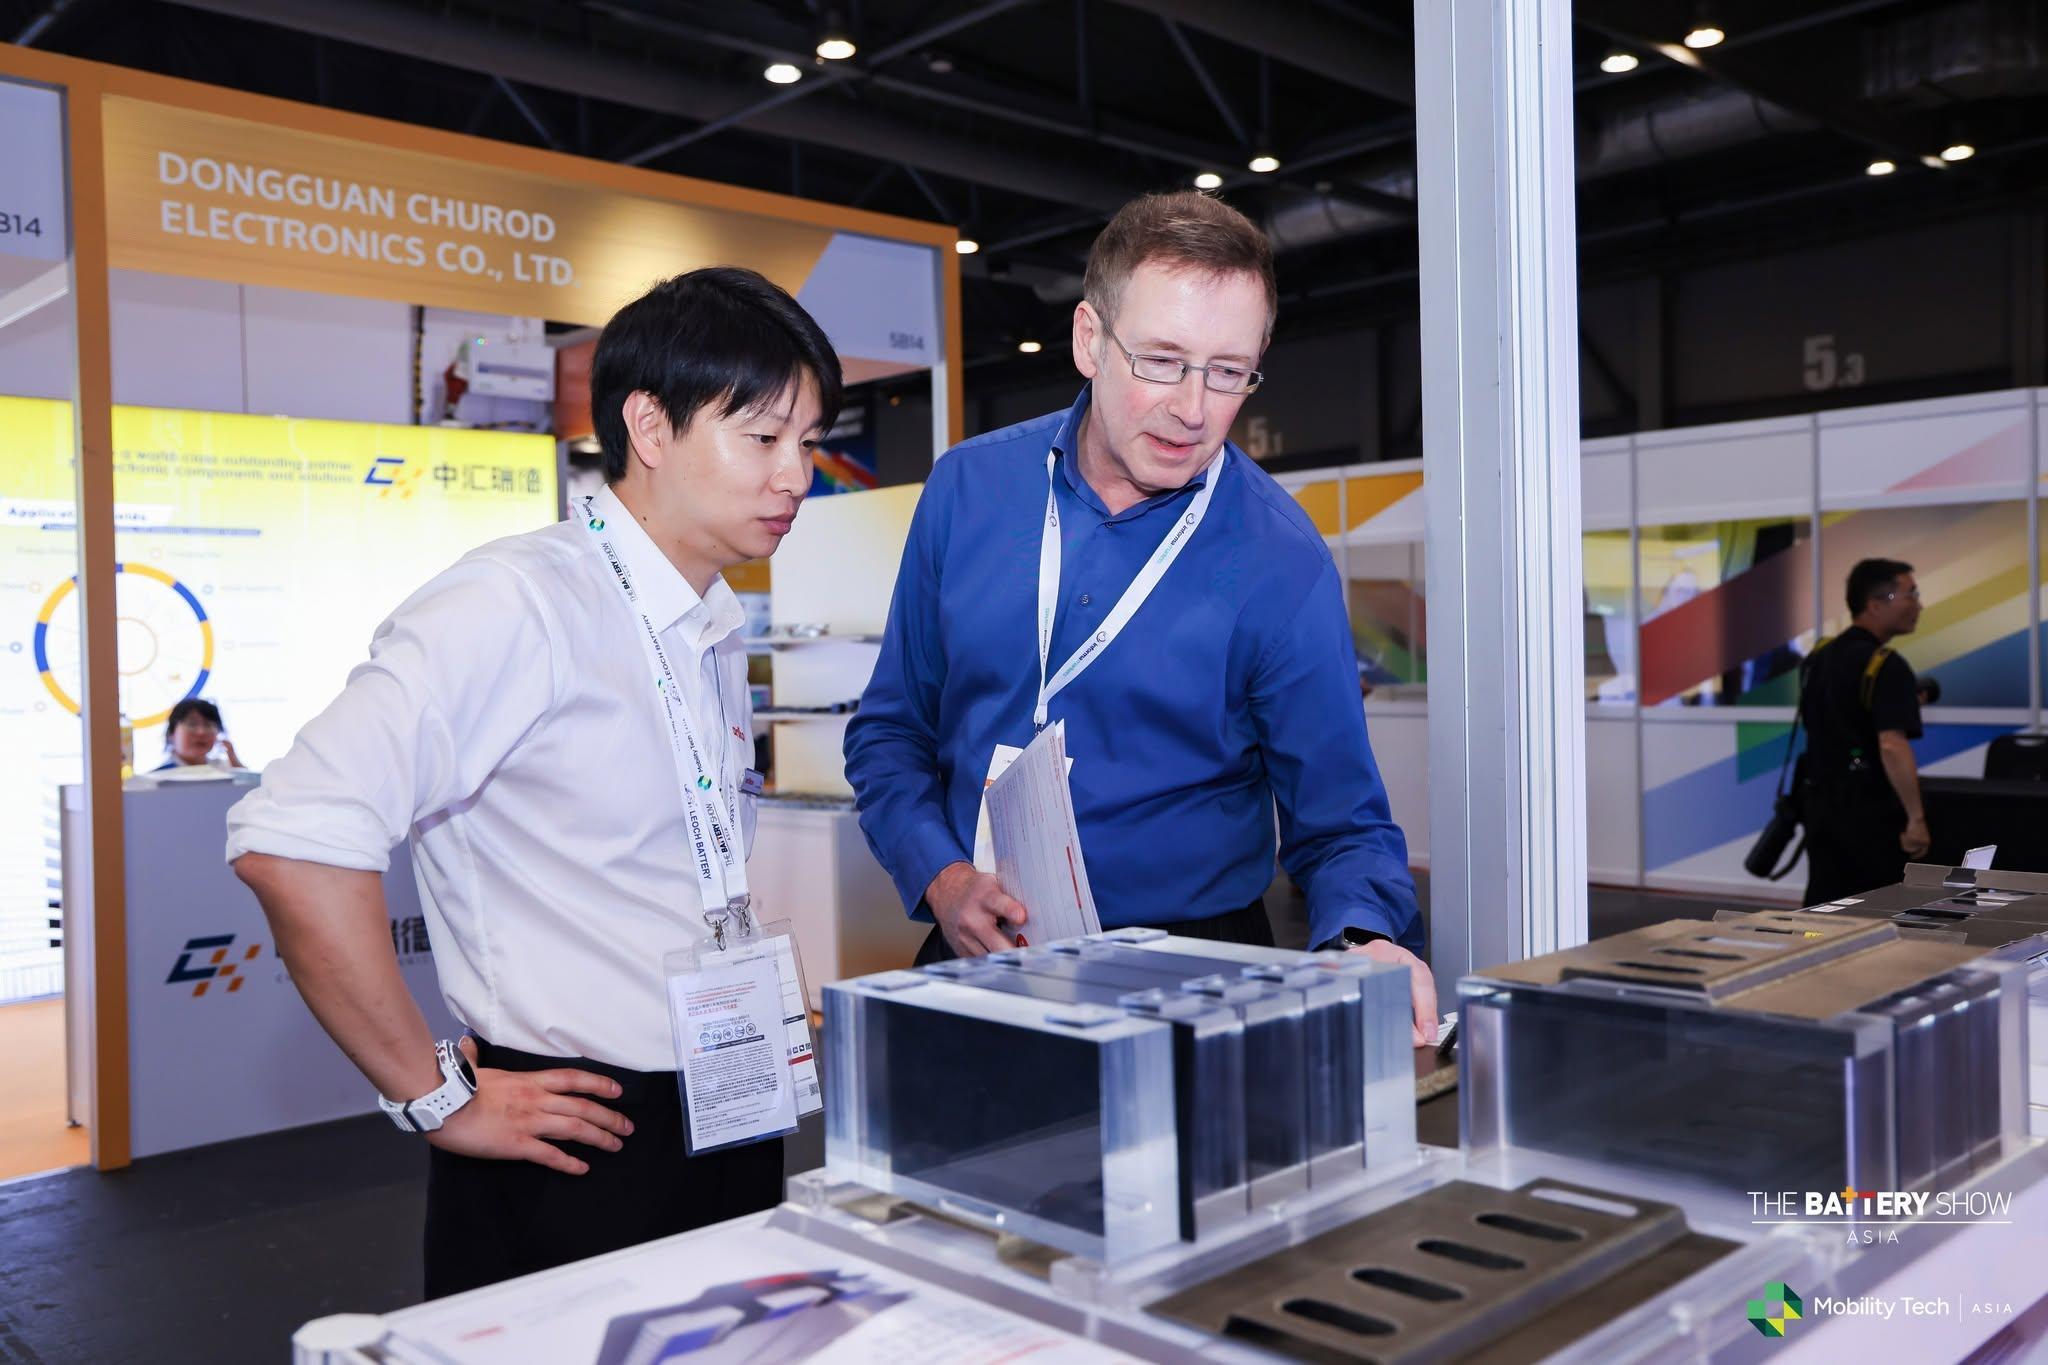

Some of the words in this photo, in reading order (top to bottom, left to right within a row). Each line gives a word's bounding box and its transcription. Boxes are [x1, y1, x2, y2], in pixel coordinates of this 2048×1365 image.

[159, 151, 395, 219] DONGGUAN
[406, 193, 556, 242] CHUROD
[160, 200, 427, 267] ELECTRONICS
[436, 240, 503, 283] CO.,
[513, 251, 582, 288] LTD.
[1803, 335, 1866, 390] 5.3
[1171, 525, 1188, 546] informa
[658, 652, 673, 680] LEOCH
[1078, 642, 1098, 661] informa
[690, 810, 702, 840] LEOCH
[712, 823, 728, 853] BATTERY
[695, 841, 712, 880] BATTERY
